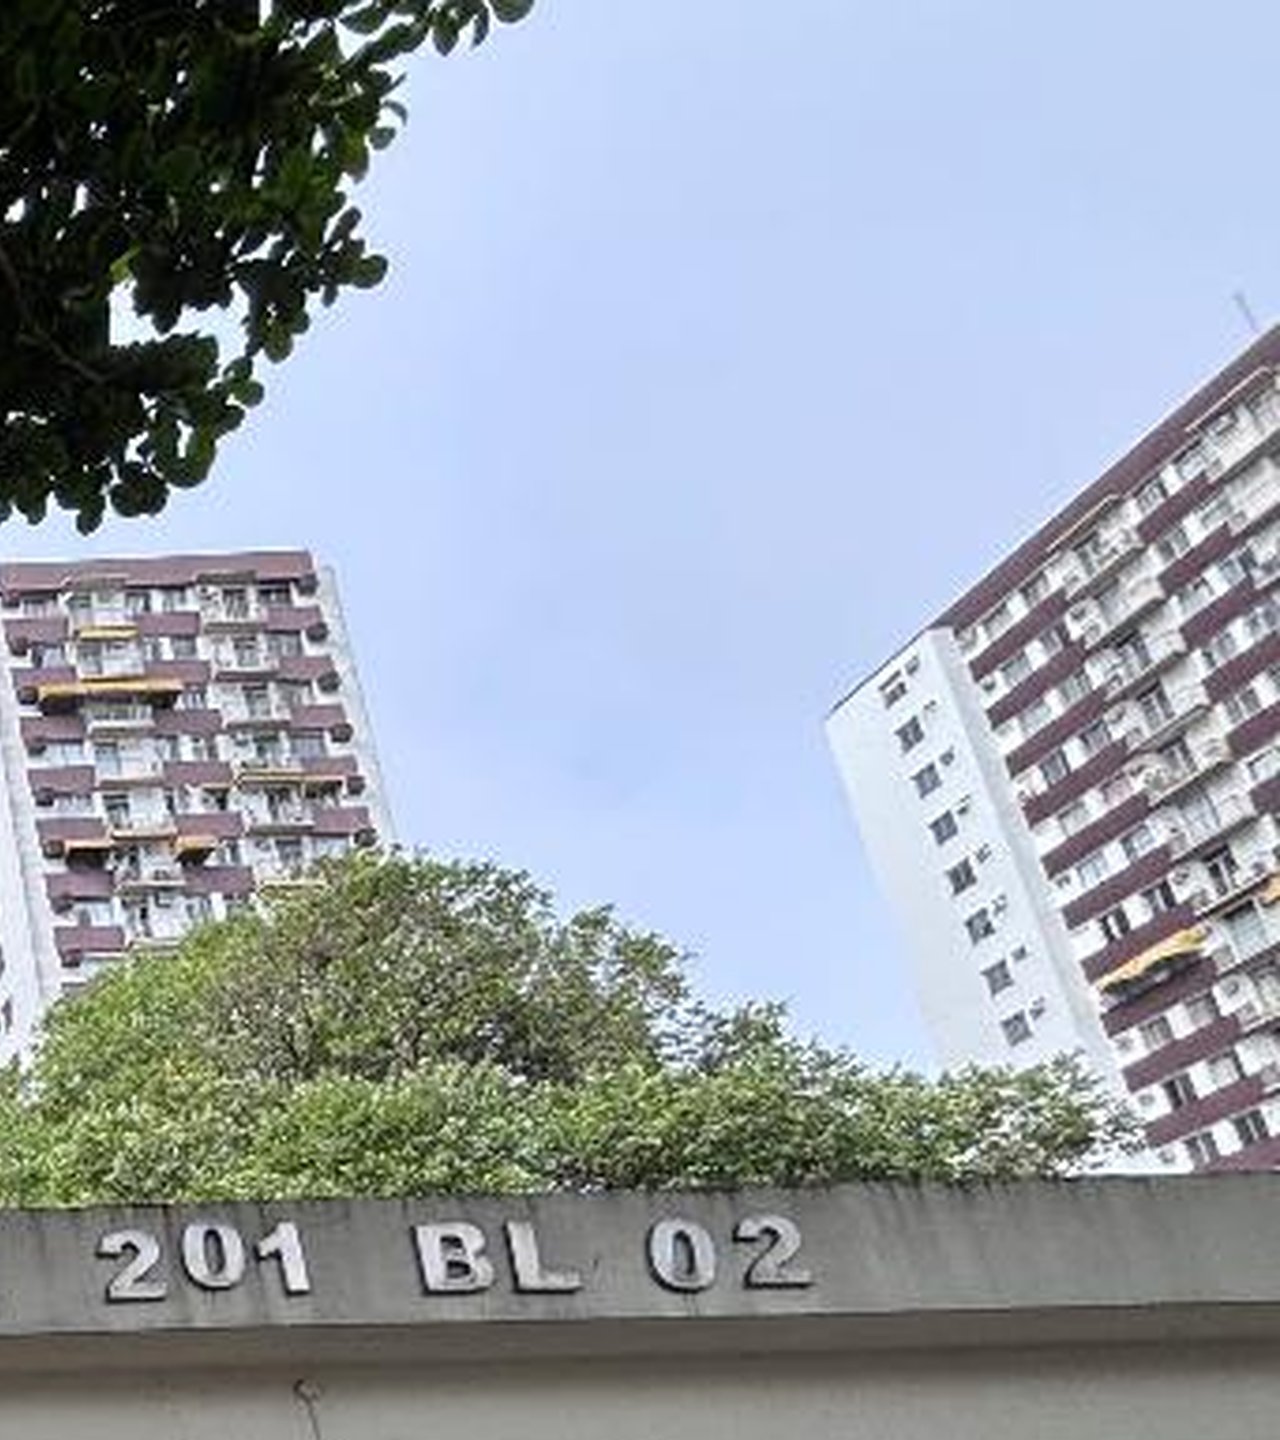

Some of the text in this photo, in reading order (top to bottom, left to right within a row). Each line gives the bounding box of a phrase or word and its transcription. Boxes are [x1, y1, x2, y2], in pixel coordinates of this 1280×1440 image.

[96, 1219, 312, 1301] 201
[411, 1219, 582, 1294] BL
[646, 1214, 815, 1292] 02
